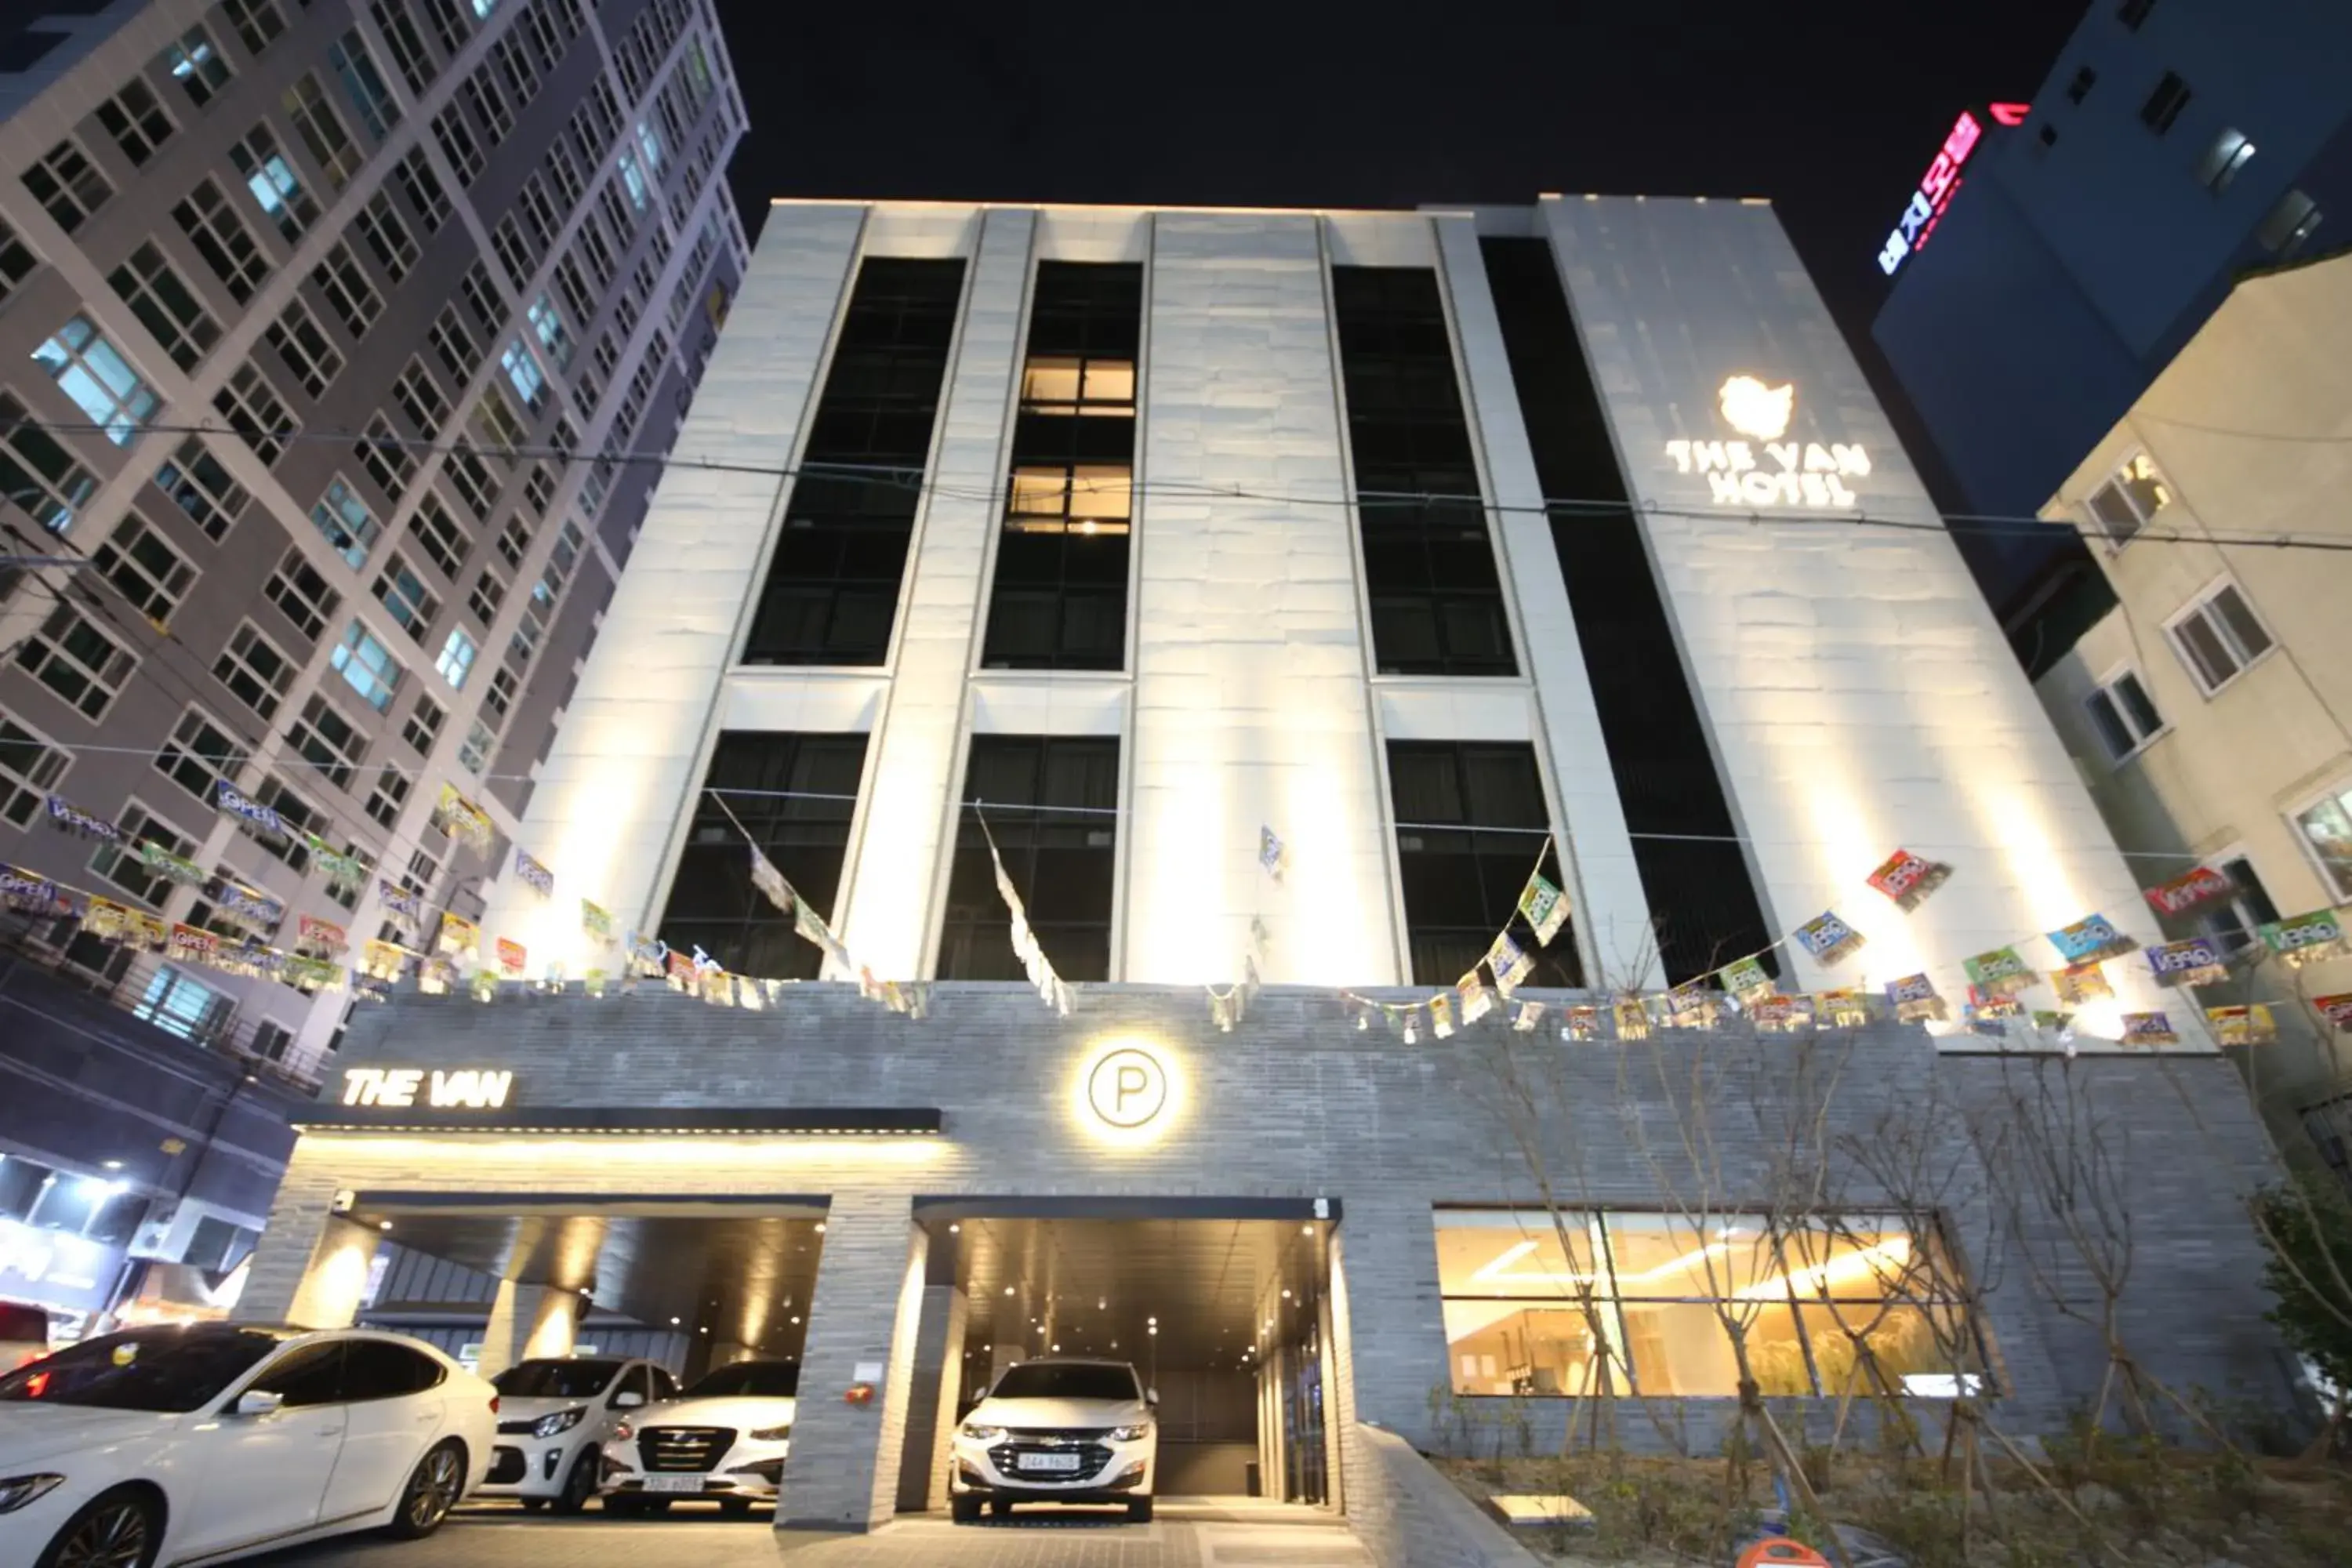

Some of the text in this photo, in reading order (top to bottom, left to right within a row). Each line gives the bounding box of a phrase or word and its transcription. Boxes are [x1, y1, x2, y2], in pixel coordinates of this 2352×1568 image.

[1666, 441, 1755, 473] THE
[1708, 471, 1855, 506] HOTEL
[343, 1069, 512, 1108] THE VAN
[1116, 1066, 1147, 1112] P
